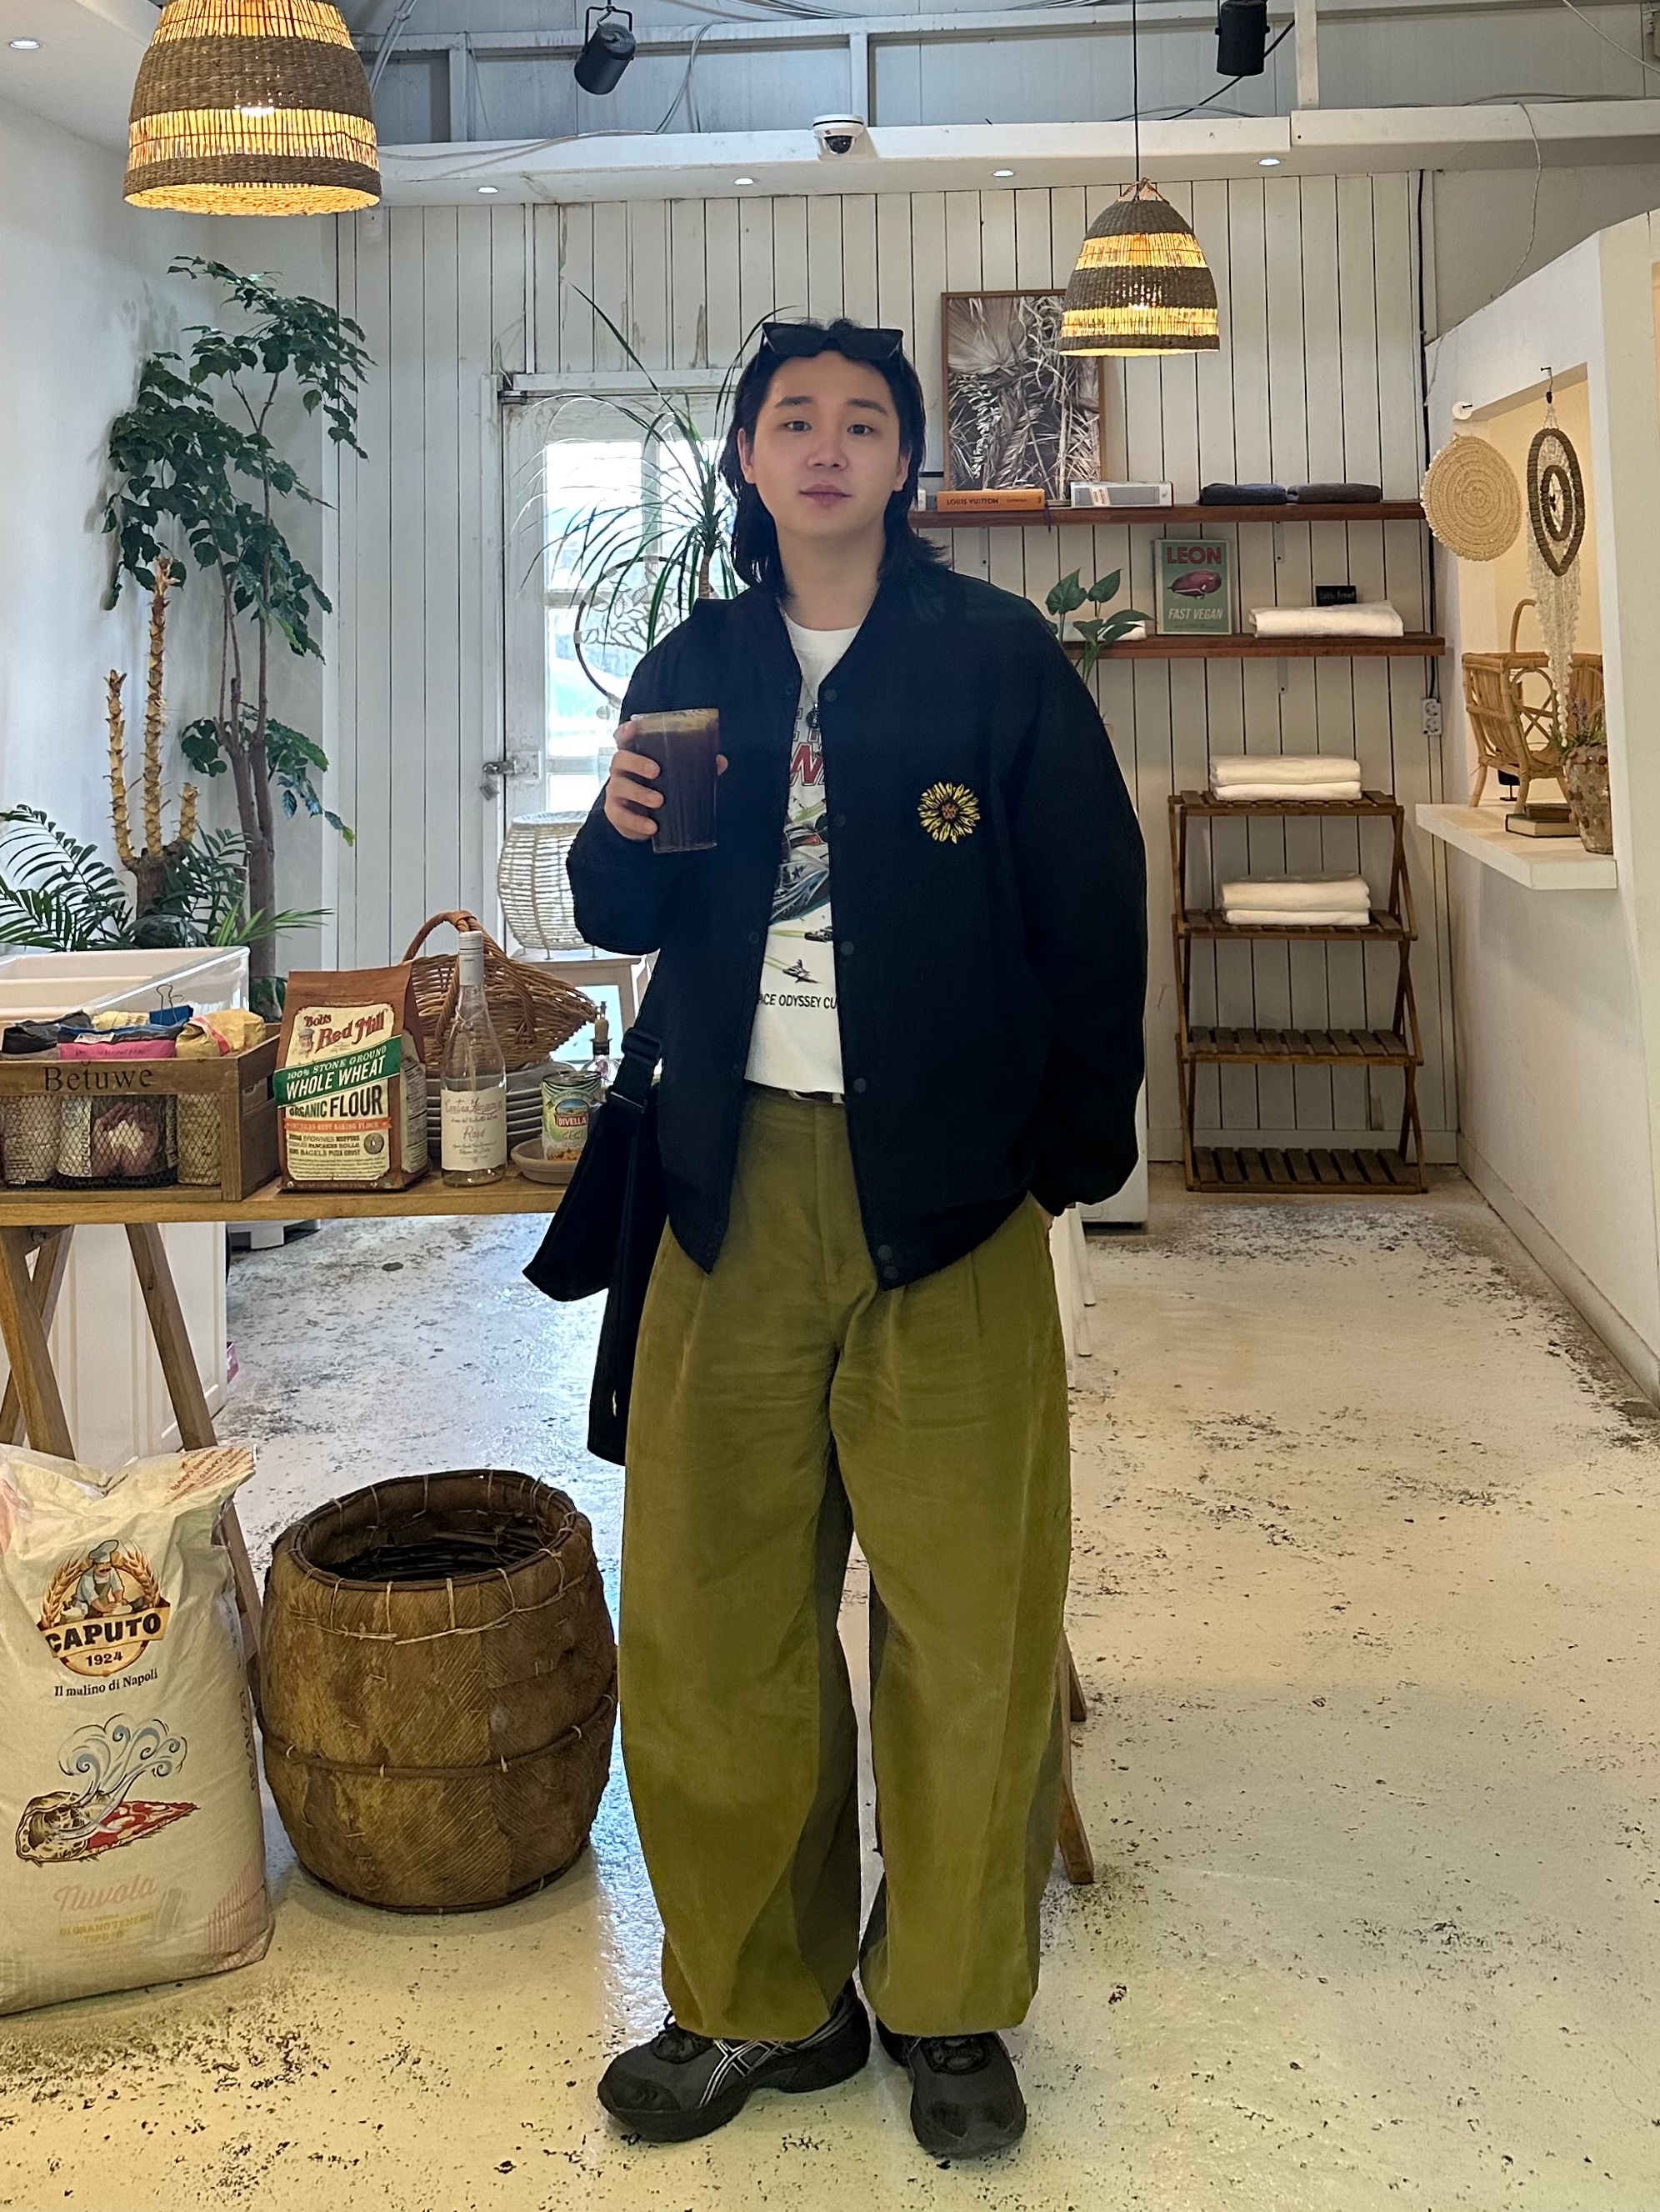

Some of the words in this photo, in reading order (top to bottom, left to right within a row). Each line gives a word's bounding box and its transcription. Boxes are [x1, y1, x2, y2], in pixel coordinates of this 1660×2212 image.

[1167, 546, 1222, 564] LEON
[1168, 608, 1191, 620] FAST
[1193, 608, 1223, 620] VEGAN
[778, 994, 822, 1008] ODYSSEY
[303, 1013, 332, 1027] Bob's
[315, 1019, 353, 1053] Red
[352, 1008, 387, 1044] Mill
[287, 1068, 310, 1080] 100%
[312, 1058, 347, 1074] STONE
[349, 1045, 387, 1064] GROUND
[44, 1066, 153, 1091] Betuwe
[286, 1071, 334, 1100] WHOLE
[338, 1055, 385, 1087] WHEAT
[289, 1100, 328, 1118] ORGANIC
[329, 1084, 382, 1118] FLOUR
[558, 1117, 587, 1126] DIVELLA
[45, 1613, 161, 1653] CAPUTO
[86, 1651, 123, 1667] 1924
[54, 1686, 63, 1697] Il
[66, 1684, 106, 1697] mulino
[108, 1679, 120, 1691] di
[122, 1668, 158, 1688] Napoli
[53, 1874, 158, 1911] Nuvola
